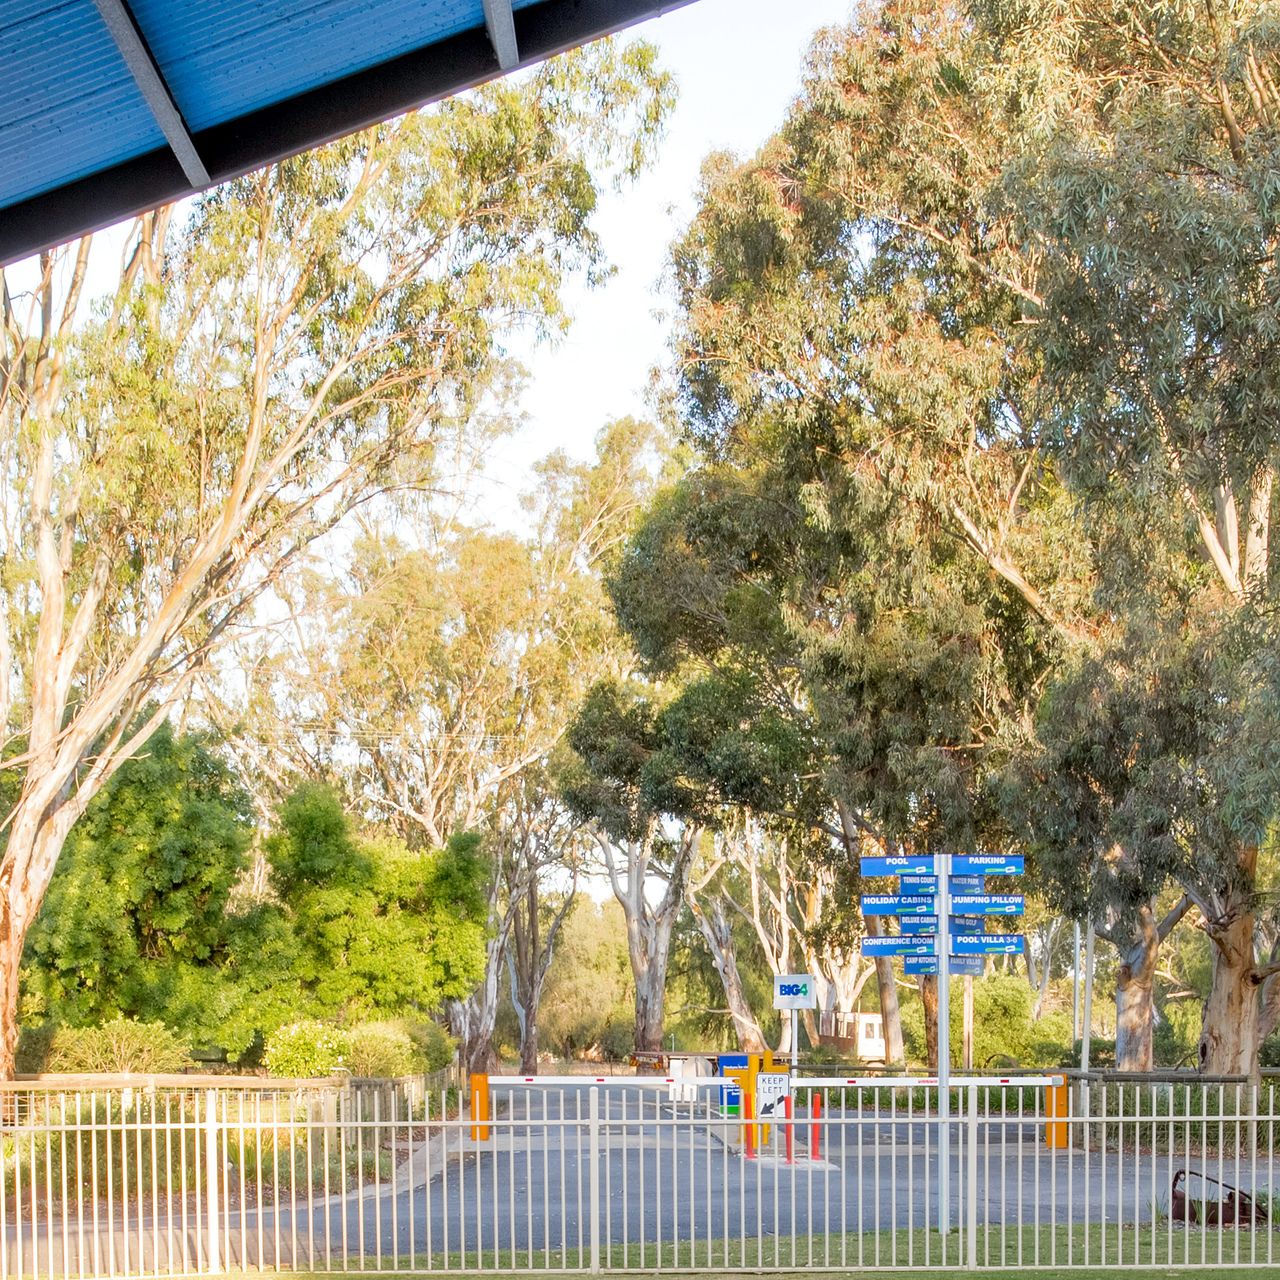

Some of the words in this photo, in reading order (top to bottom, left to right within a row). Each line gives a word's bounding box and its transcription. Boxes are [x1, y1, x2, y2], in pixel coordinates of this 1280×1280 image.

[952, 896, 991, 904] JUMPING
[991, 896, 1023, 904] PILLOW
[920, 916, 937, 924] CABINS
[957, 936, 979, 944] POOL
[980, 936, 1005, 944] VILLA
[1005, 936, 1018, 944] 3-6
[780, 983, 808, 996] BIG4
